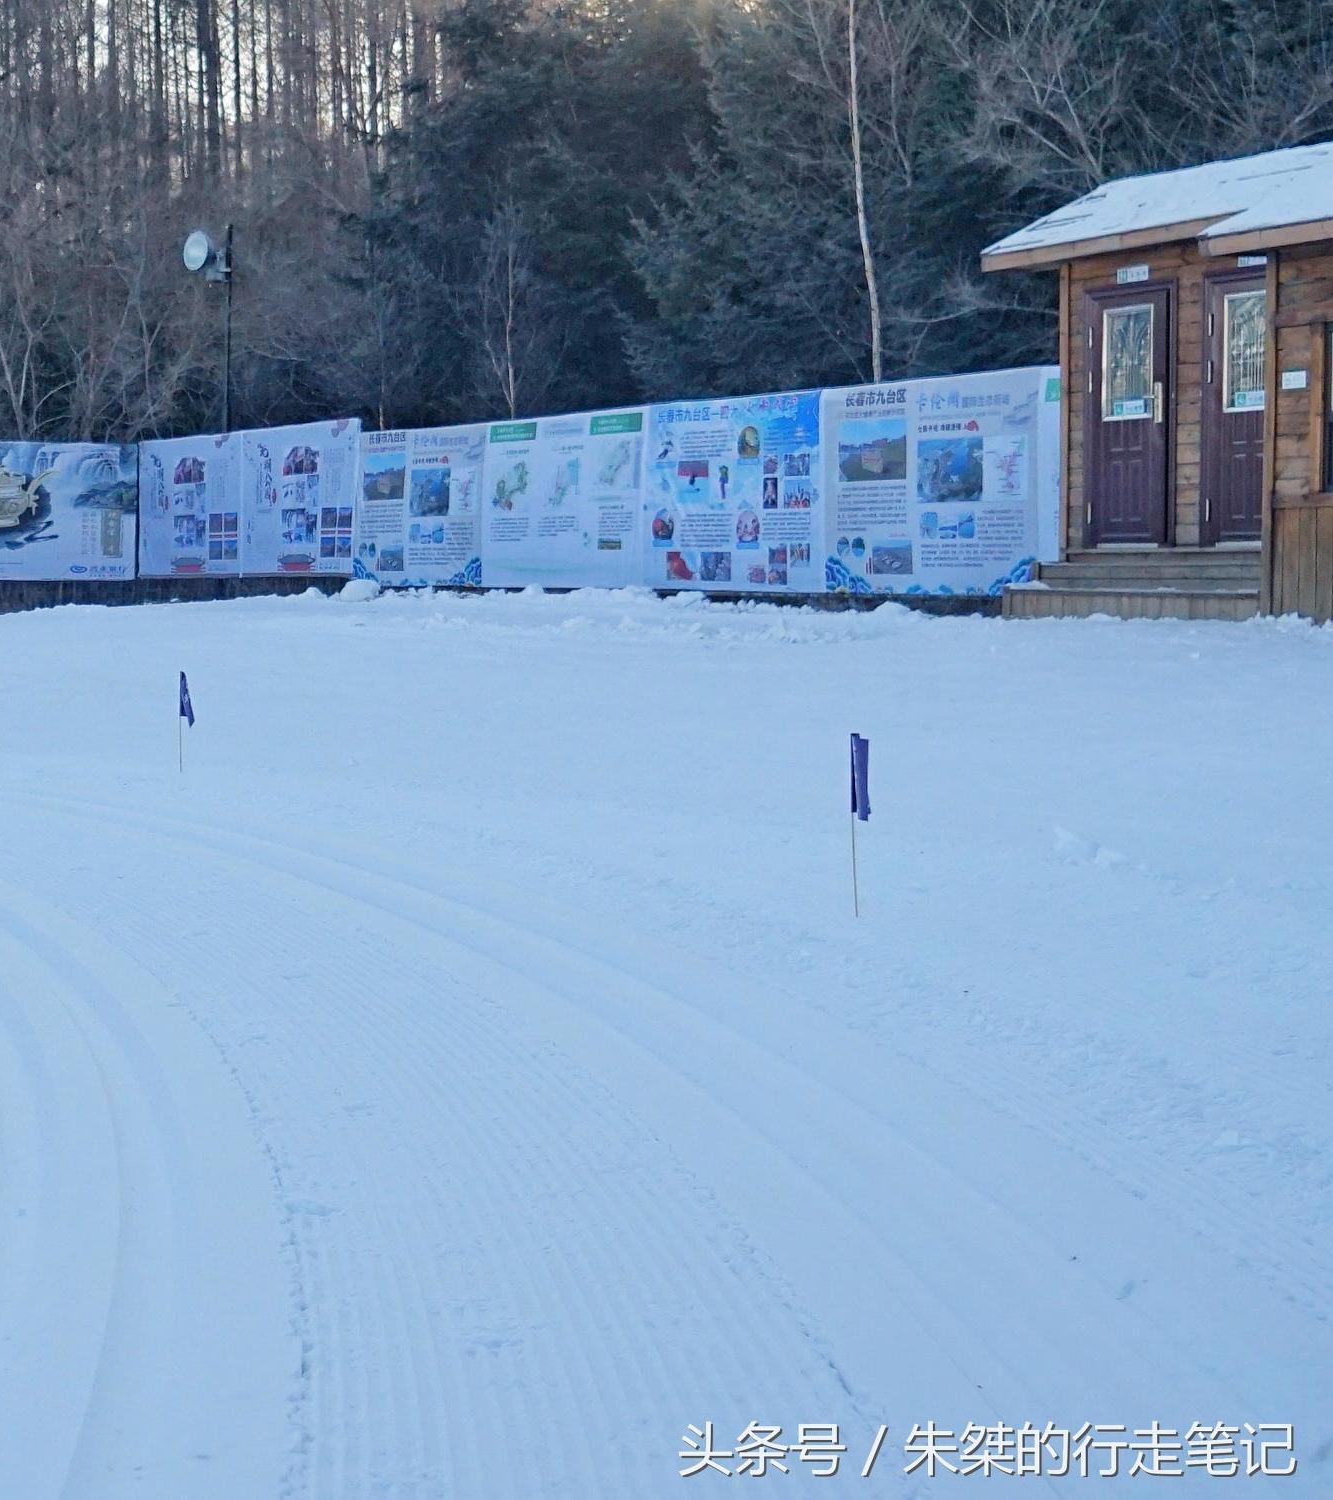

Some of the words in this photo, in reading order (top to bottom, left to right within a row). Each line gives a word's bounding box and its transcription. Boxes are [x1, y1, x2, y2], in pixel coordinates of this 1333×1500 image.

[845, 389, 907, 407] 长春市九台区
